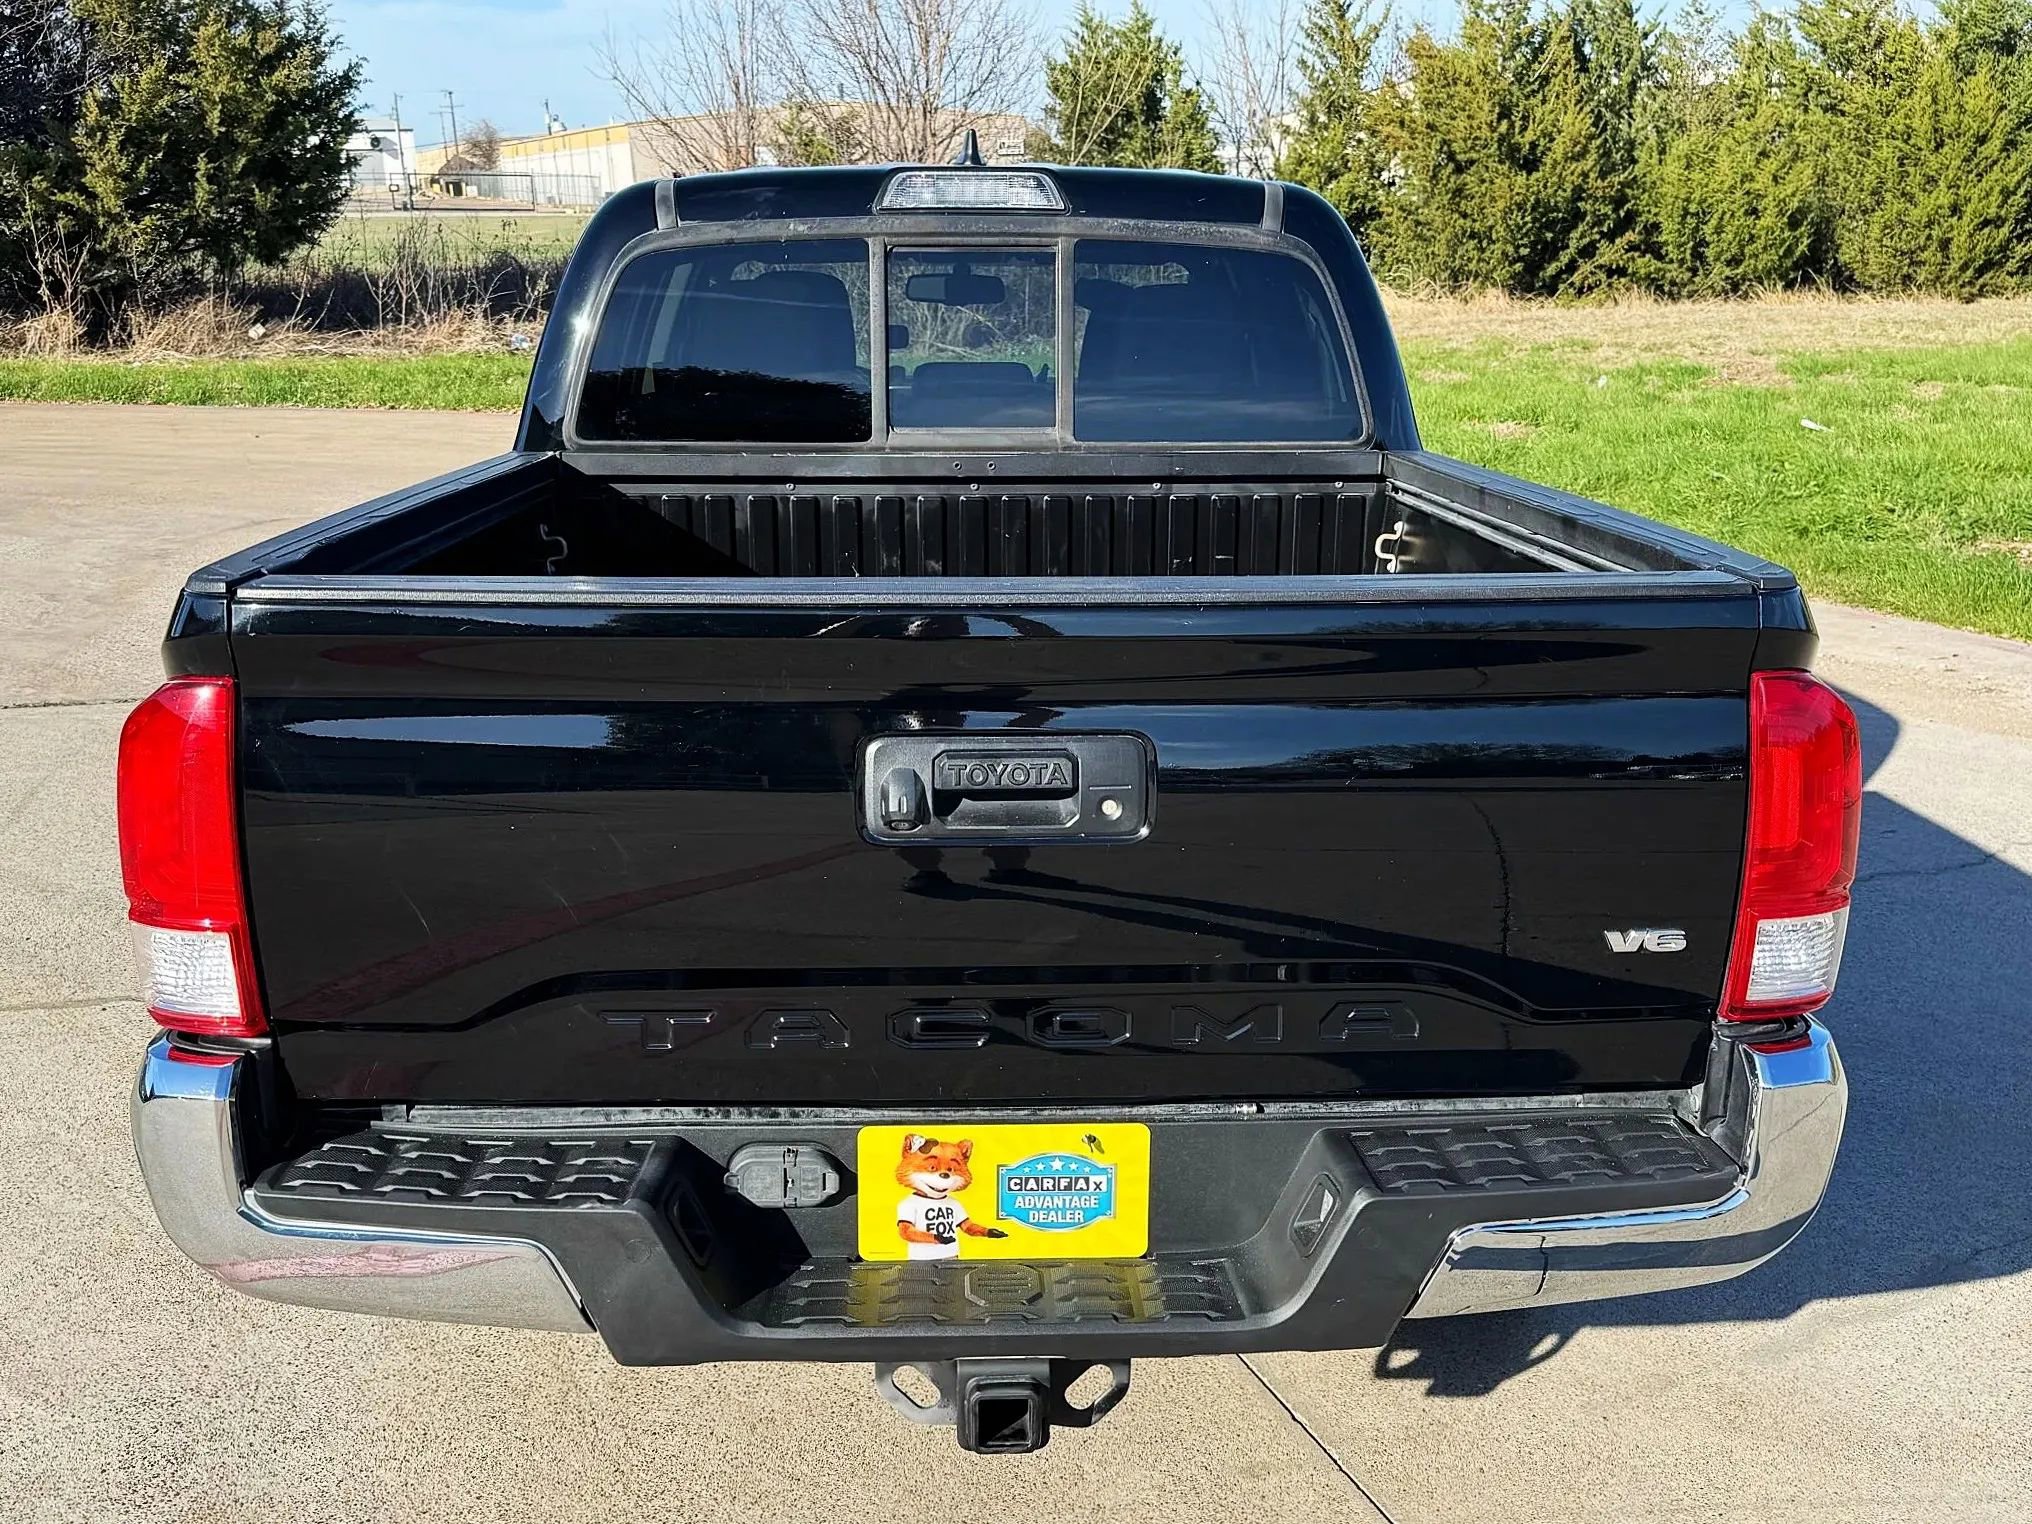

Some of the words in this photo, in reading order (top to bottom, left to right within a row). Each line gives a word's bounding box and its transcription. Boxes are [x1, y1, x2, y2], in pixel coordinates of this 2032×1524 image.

[948, 761, 1068, 787] TOYOTA
[1604, 928, 1687, 953] V6
[597, 1001, 1421, 1051] TACOMA
[1008, 1177, 1103, 1192] CARFAX
[1014, 1195, 1100, 1209] ADVANTAGE
[924, 1206, 954, 1221] CAR
[1029, 1210, 1085, 1223] DEALER
[926, 1221, 956, 1236] FOX
